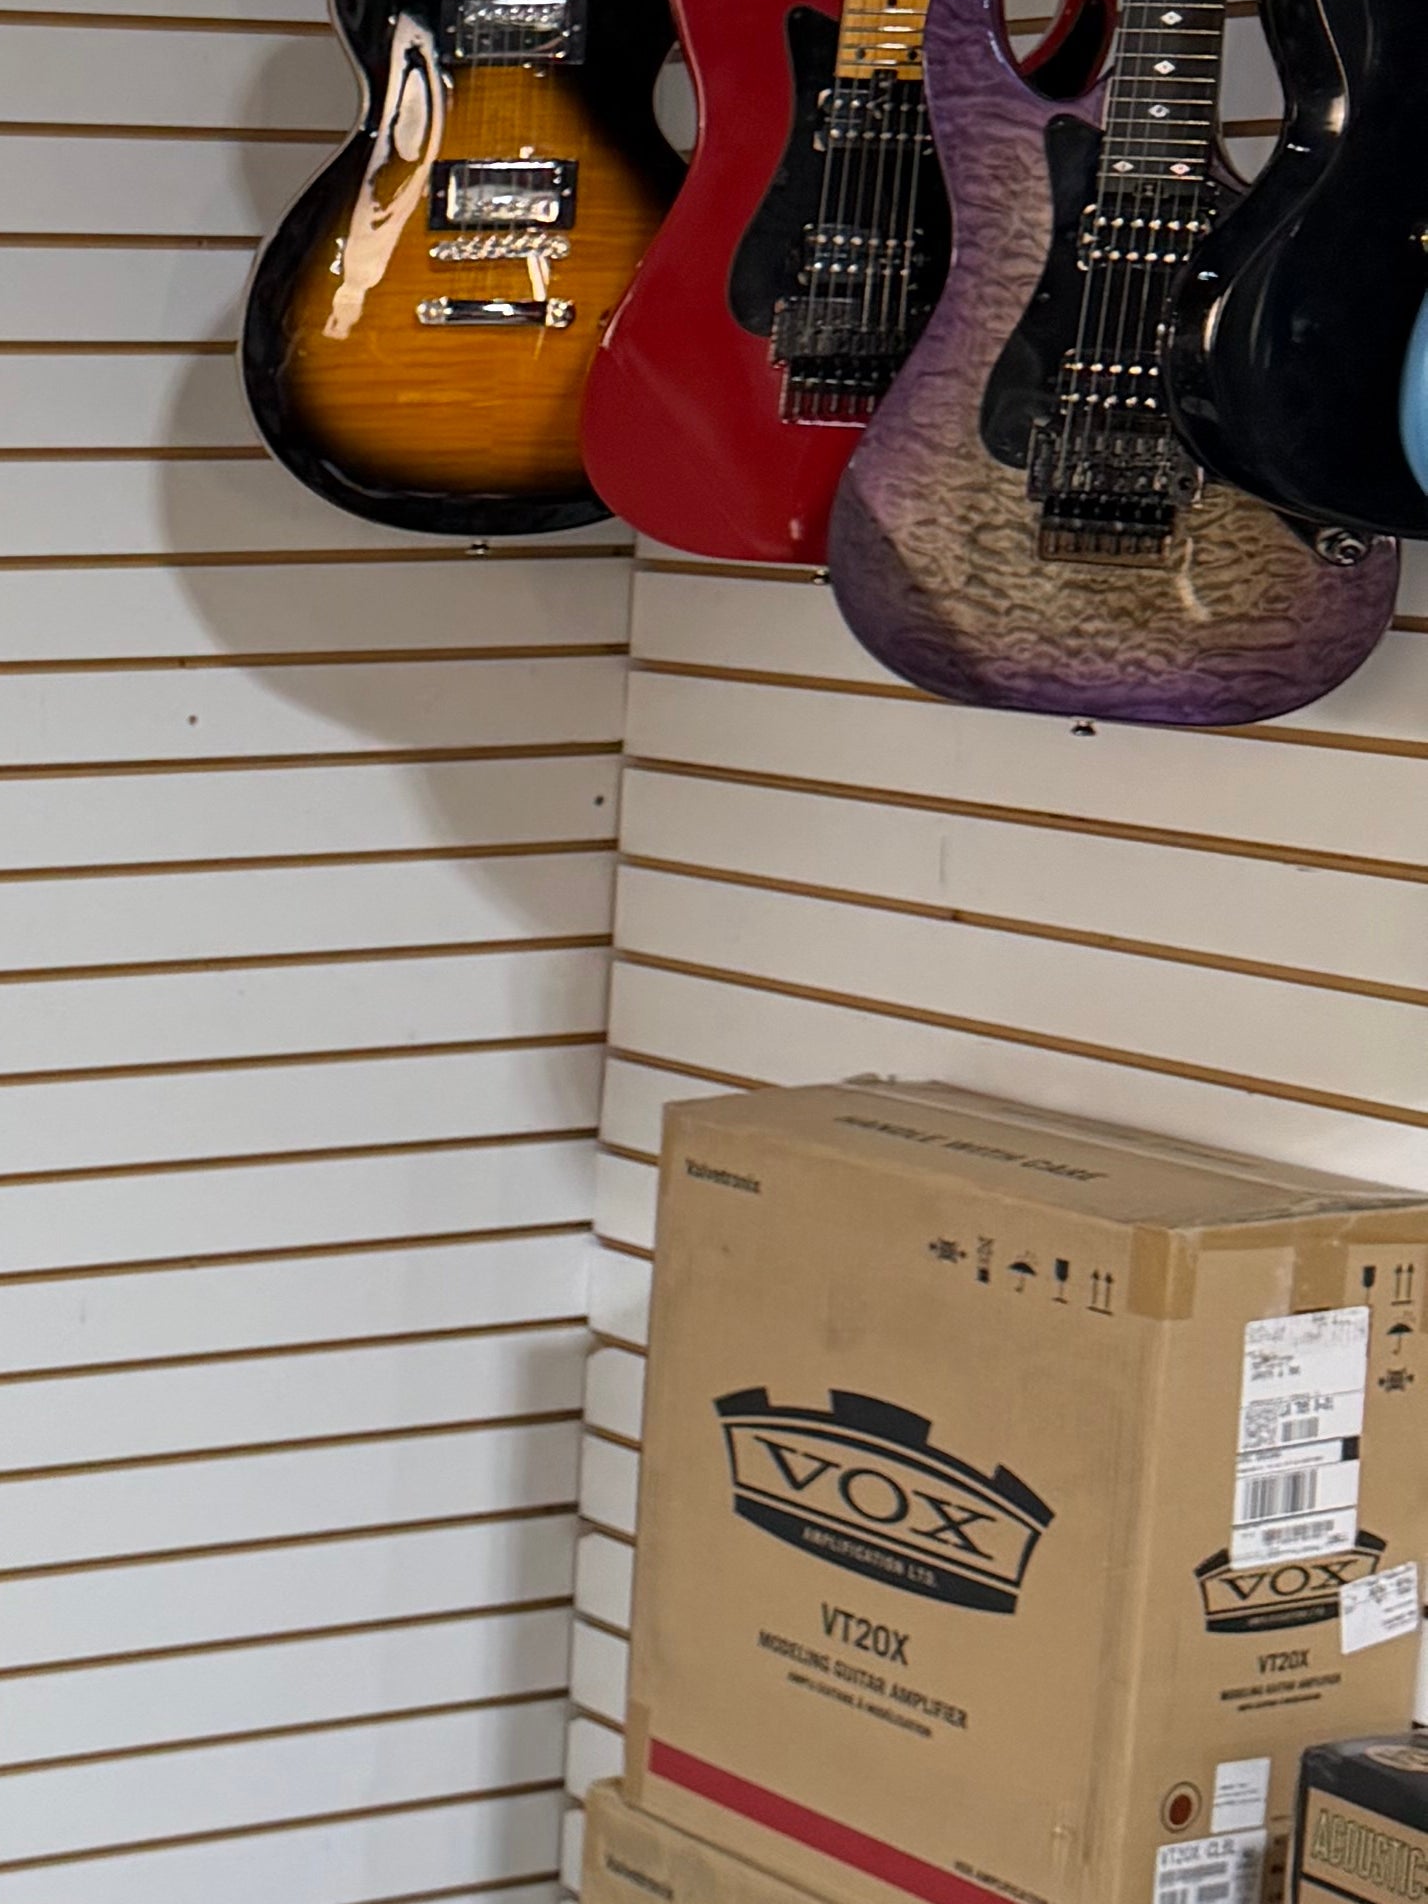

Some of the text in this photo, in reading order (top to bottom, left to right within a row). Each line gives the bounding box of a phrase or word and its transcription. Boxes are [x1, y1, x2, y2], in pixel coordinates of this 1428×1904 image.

[752, 1434, 998, 1561] VOX
[1219, 1558, 1361, 1602] VOX
[820, 1601, 910, 1667] VT20X
[1257, 1648, 1311, 1675] VT20X
[756, 1628, 831, 1675] MODELING
[833, 1658, 887, 1695] GUITAR
[890, 1682, 969, 1730] AMPLIFIER
[1310, 1806, 1428, 1902] ACOUSTIC
